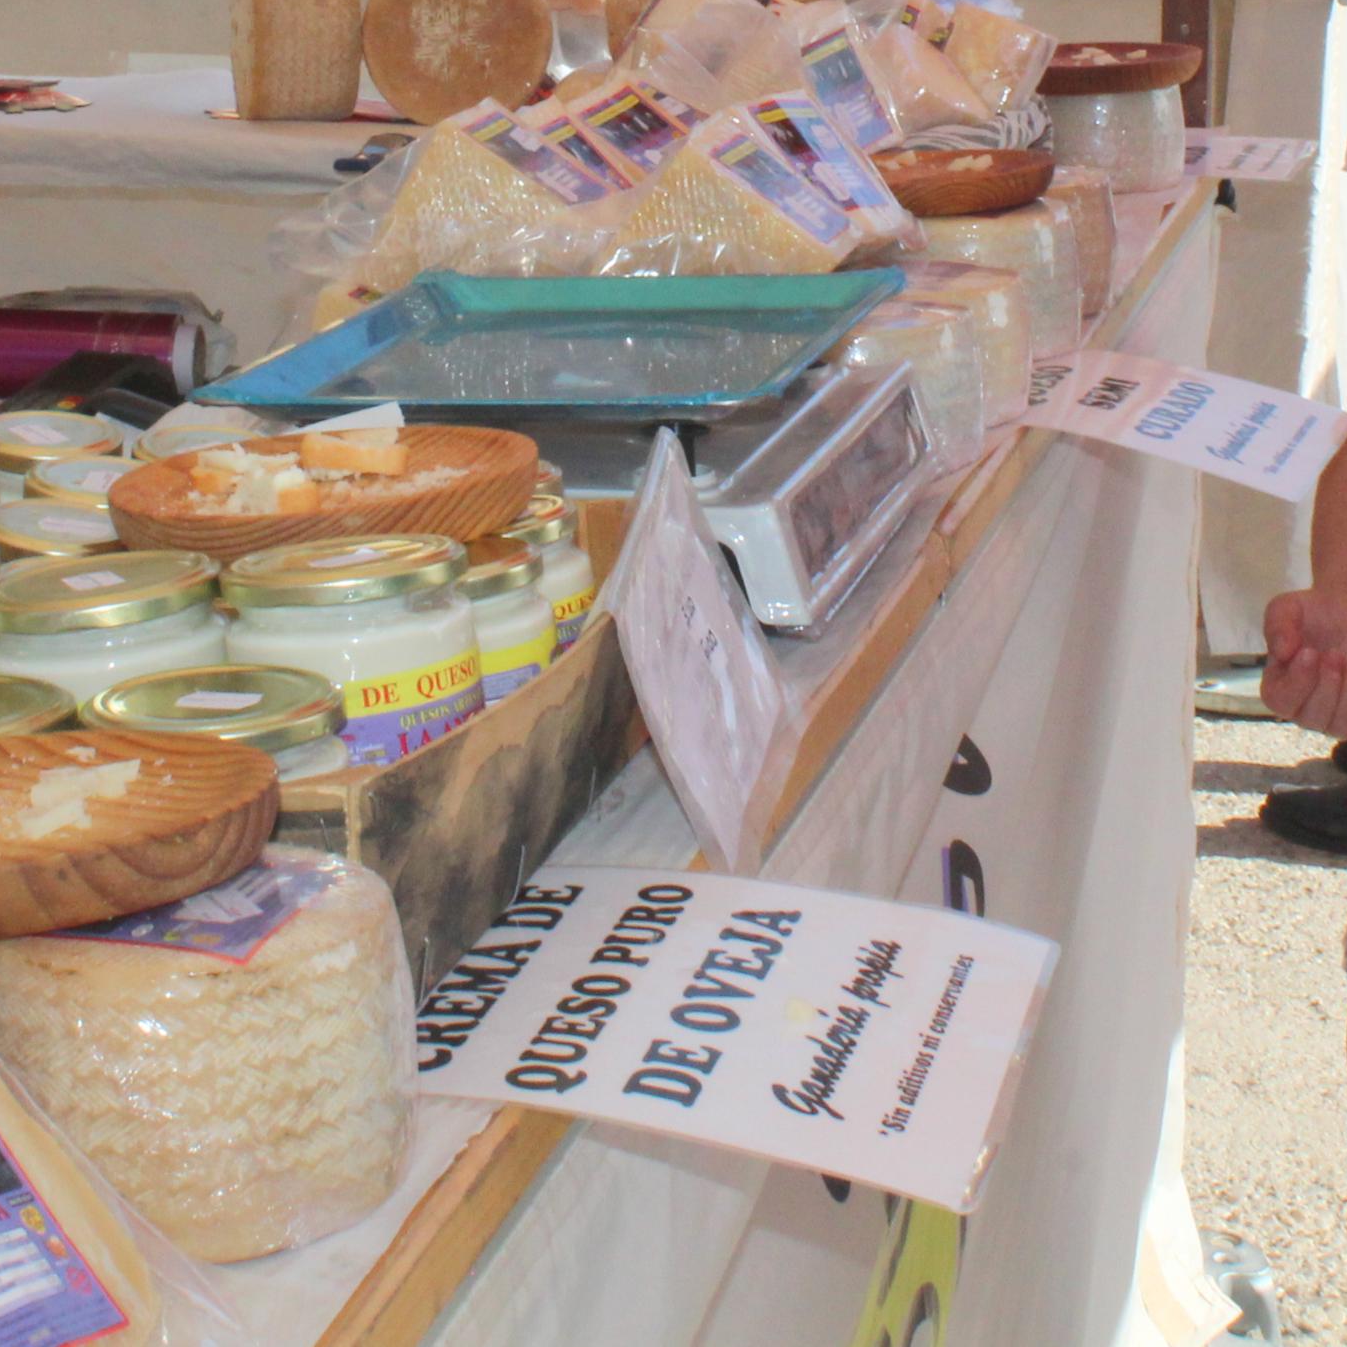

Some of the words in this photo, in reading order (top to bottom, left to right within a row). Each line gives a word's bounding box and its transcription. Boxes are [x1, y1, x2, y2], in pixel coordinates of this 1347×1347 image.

[1135, 380, 1216, 441] CURADO
[361, 681, 400, 709] DE
[416, 654, 478, 699] QUESO
[506, 881, 584, 933] DE
[504, 973, 632, 1096] QUESO
[591, 881, 694, 966] PURO
[667, 908, 803, 1038] OVEJA
[931, 953, 976, 1036] conservantes
[771, 1002, 871, 1122] Ganadería
[848, 937, 904, 1022] propia
[926, 1033, 943, 1054] ni
[621, 1038, 725, 1107] DE
[903, 1048, 933, 1107] aditivos
